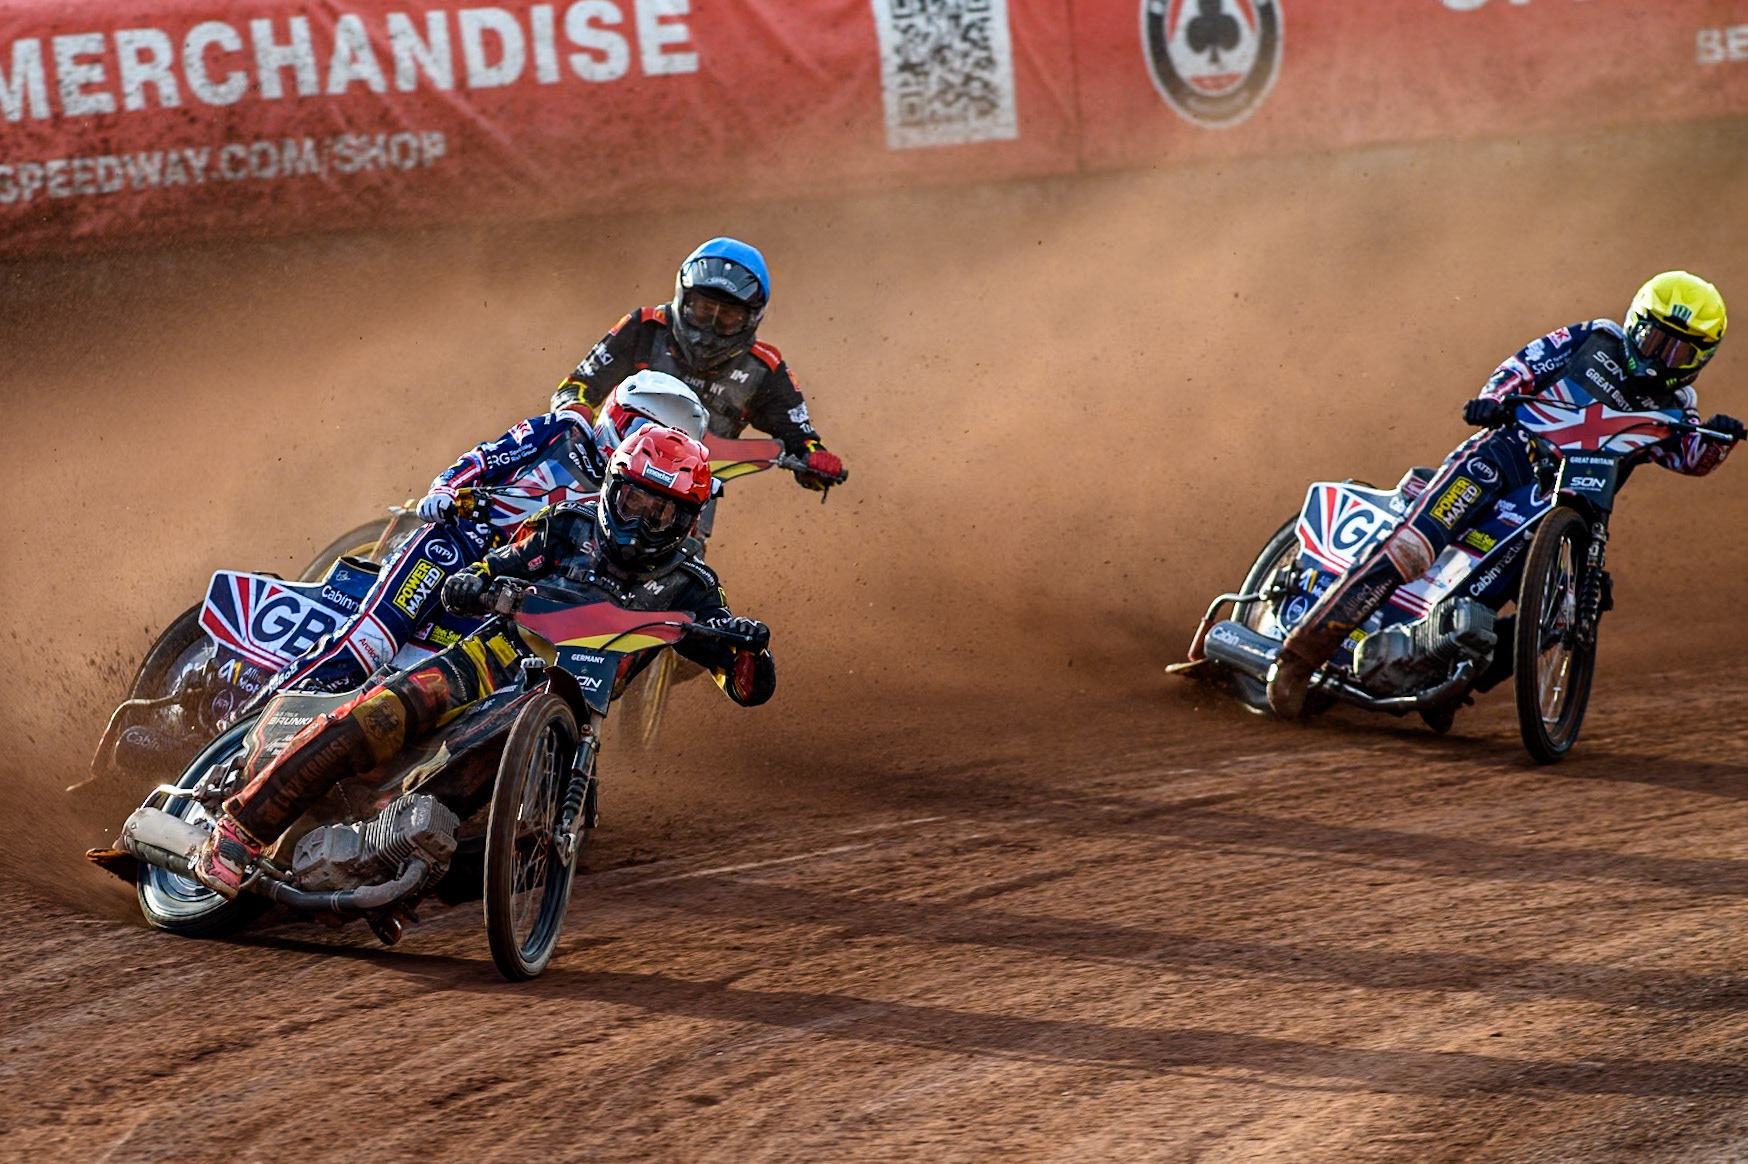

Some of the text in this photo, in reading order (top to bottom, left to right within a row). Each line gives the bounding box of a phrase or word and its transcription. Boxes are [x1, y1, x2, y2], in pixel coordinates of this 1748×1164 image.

[0, 0, 698, 122] MERCHANDISE
[1585, 368, 1615, 393] GREAT
[1570, 456, 1615, 466] GREAT BRITAIN
[1570, 477, 1606, 488] SON
[1435, 480, 1470, 518] POWER
[1443, 485, 1478, 526] MAXED
[430, 544, 453, 560] ATPI
[396, 562, 431, 607] POWER
[406, 567, 441, 616] MAXED
[252, 596, 337, 658] GB
[571, 653, 605, 664] GERMANY
[574, 675, 603, 688] ON
